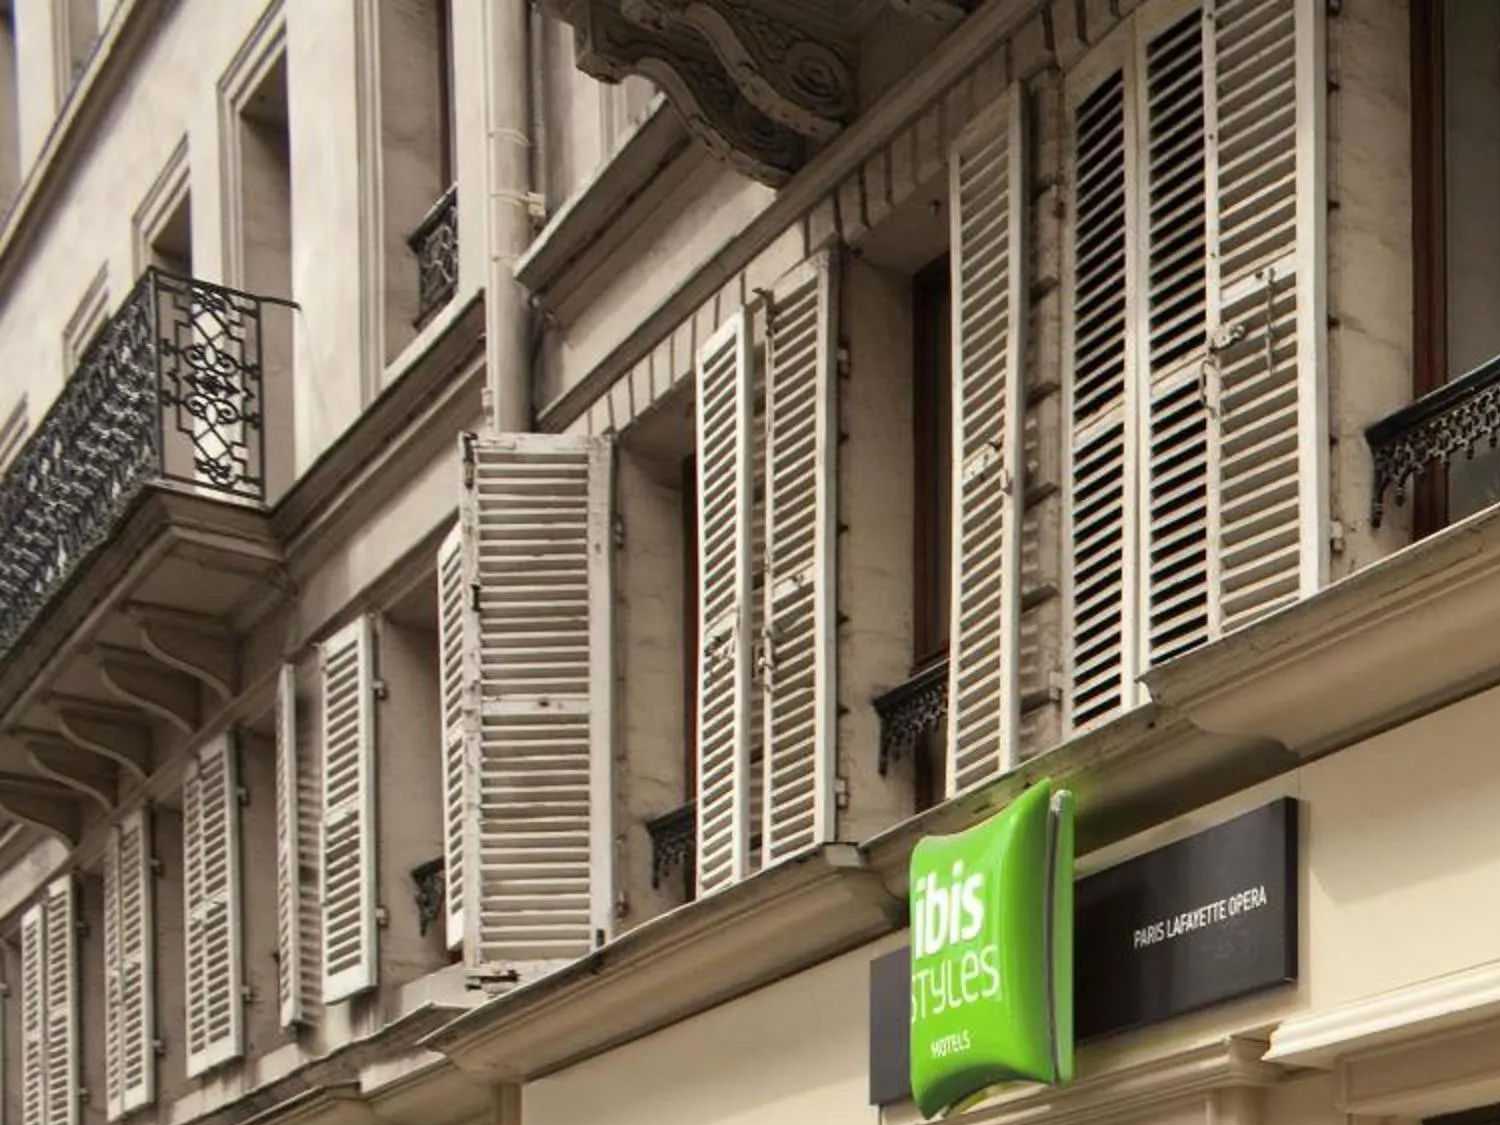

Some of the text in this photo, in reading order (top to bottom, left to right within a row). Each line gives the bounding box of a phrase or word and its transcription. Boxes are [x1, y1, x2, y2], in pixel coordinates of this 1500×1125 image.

[914, 859, 984, 960] ibis
[1133, 885, 1267, 949] PARIS LAFAYETTE OPERA
[931, 1029, 971, 1058] HOTELS
